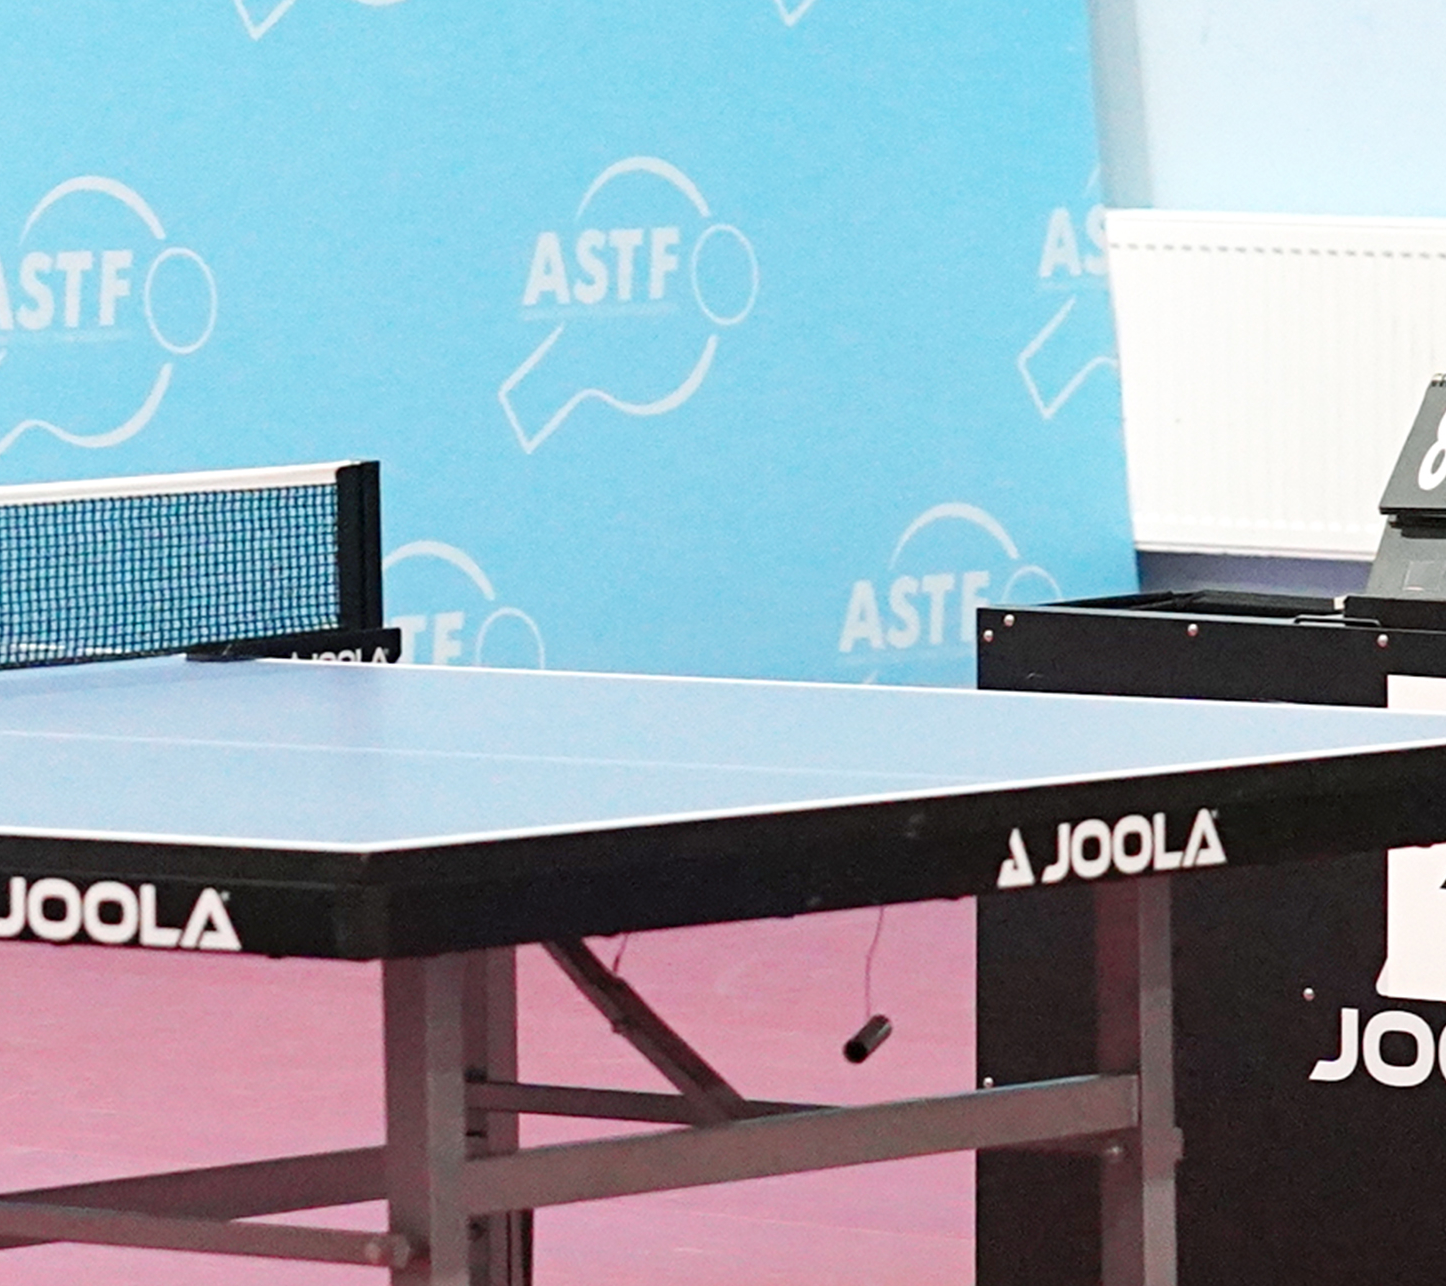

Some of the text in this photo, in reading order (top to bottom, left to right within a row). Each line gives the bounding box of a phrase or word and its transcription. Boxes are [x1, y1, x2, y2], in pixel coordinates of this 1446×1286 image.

[522, 228, 680, 306] ASTF
[839, 571, 990, 652] ASTF
[1041, 809, 1226, 882] JOOLA
